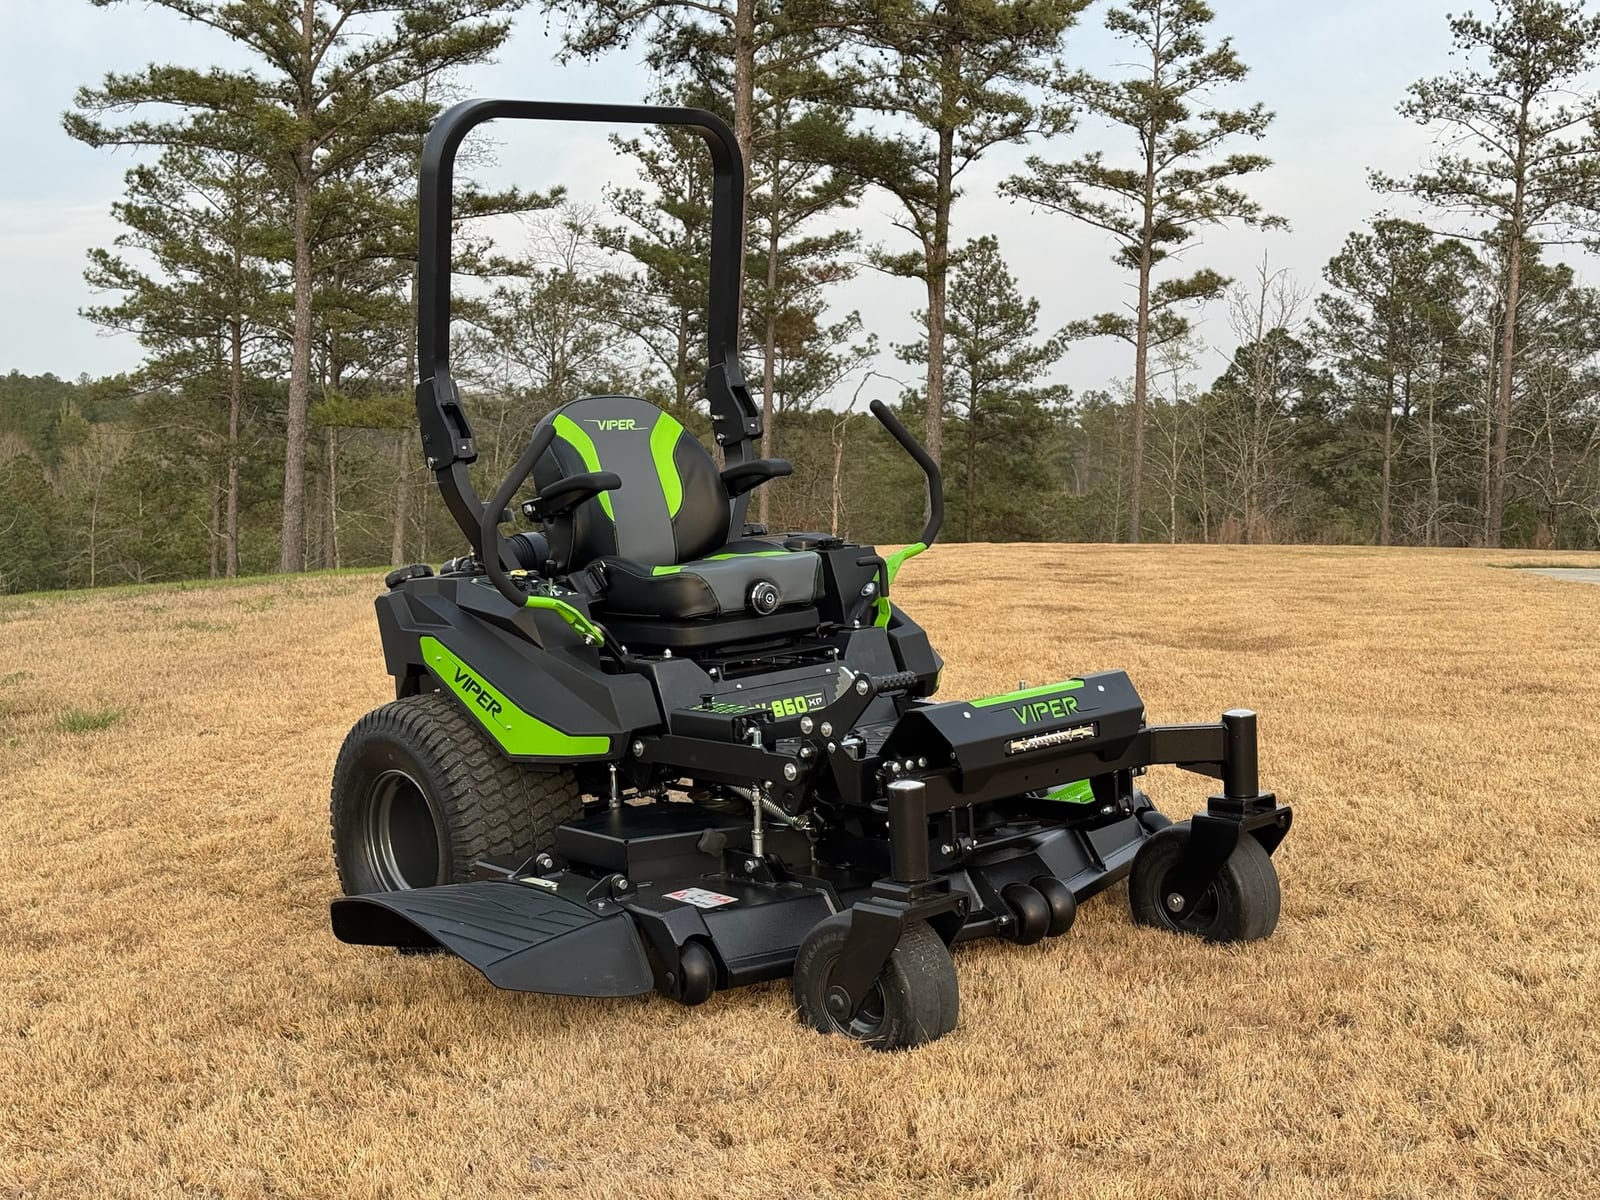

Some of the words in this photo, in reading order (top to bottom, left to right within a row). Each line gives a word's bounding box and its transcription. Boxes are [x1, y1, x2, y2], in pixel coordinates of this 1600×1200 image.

[596, 419, 637, 431] VIPER
[451, 665, 503, 719] VIPER
[808, 697, 822, 707] XP
[1010, 695, 1080, 725] VIPER
